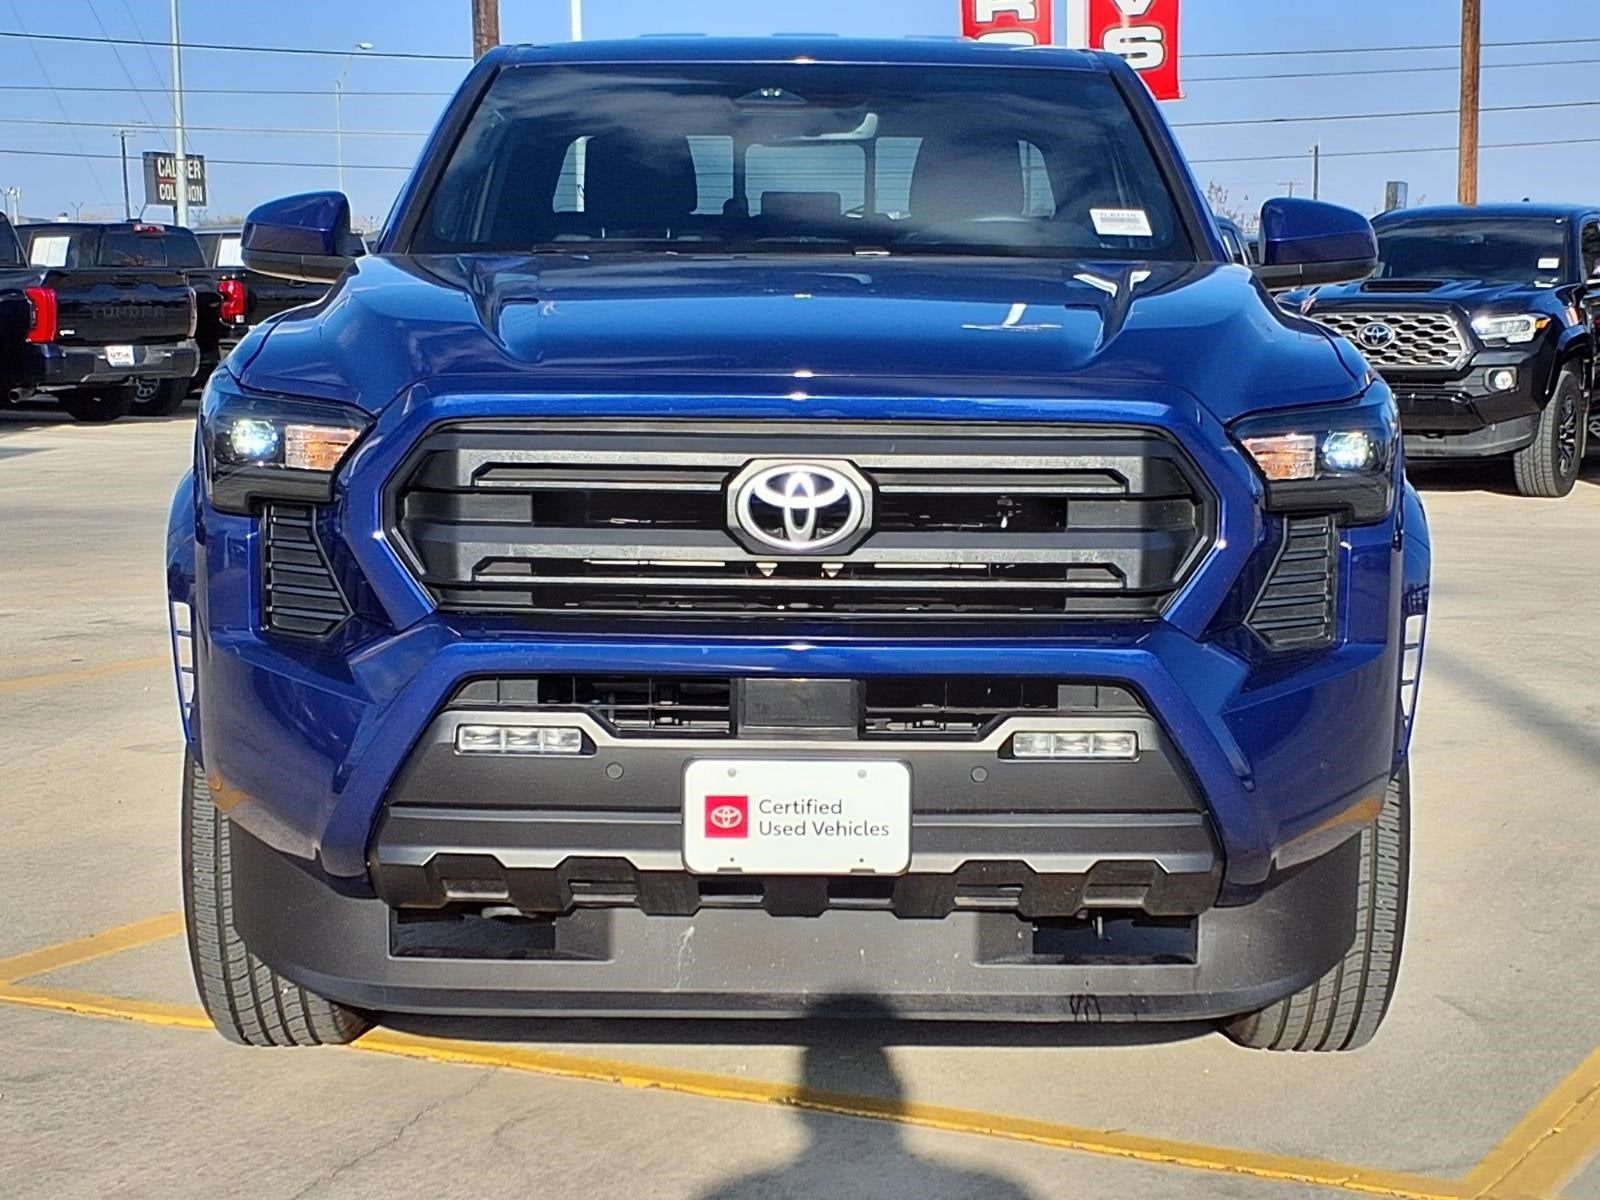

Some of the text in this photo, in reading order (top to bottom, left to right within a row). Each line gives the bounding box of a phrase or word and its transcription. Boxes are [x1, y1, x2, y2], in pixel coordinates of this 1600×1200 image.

[157, 157, 202, 179] CALER
[159, 183, 203, 202] COLION
[758, 798, 842, 815] Certified
[759, 819, 890, 836] Used Vehicles
